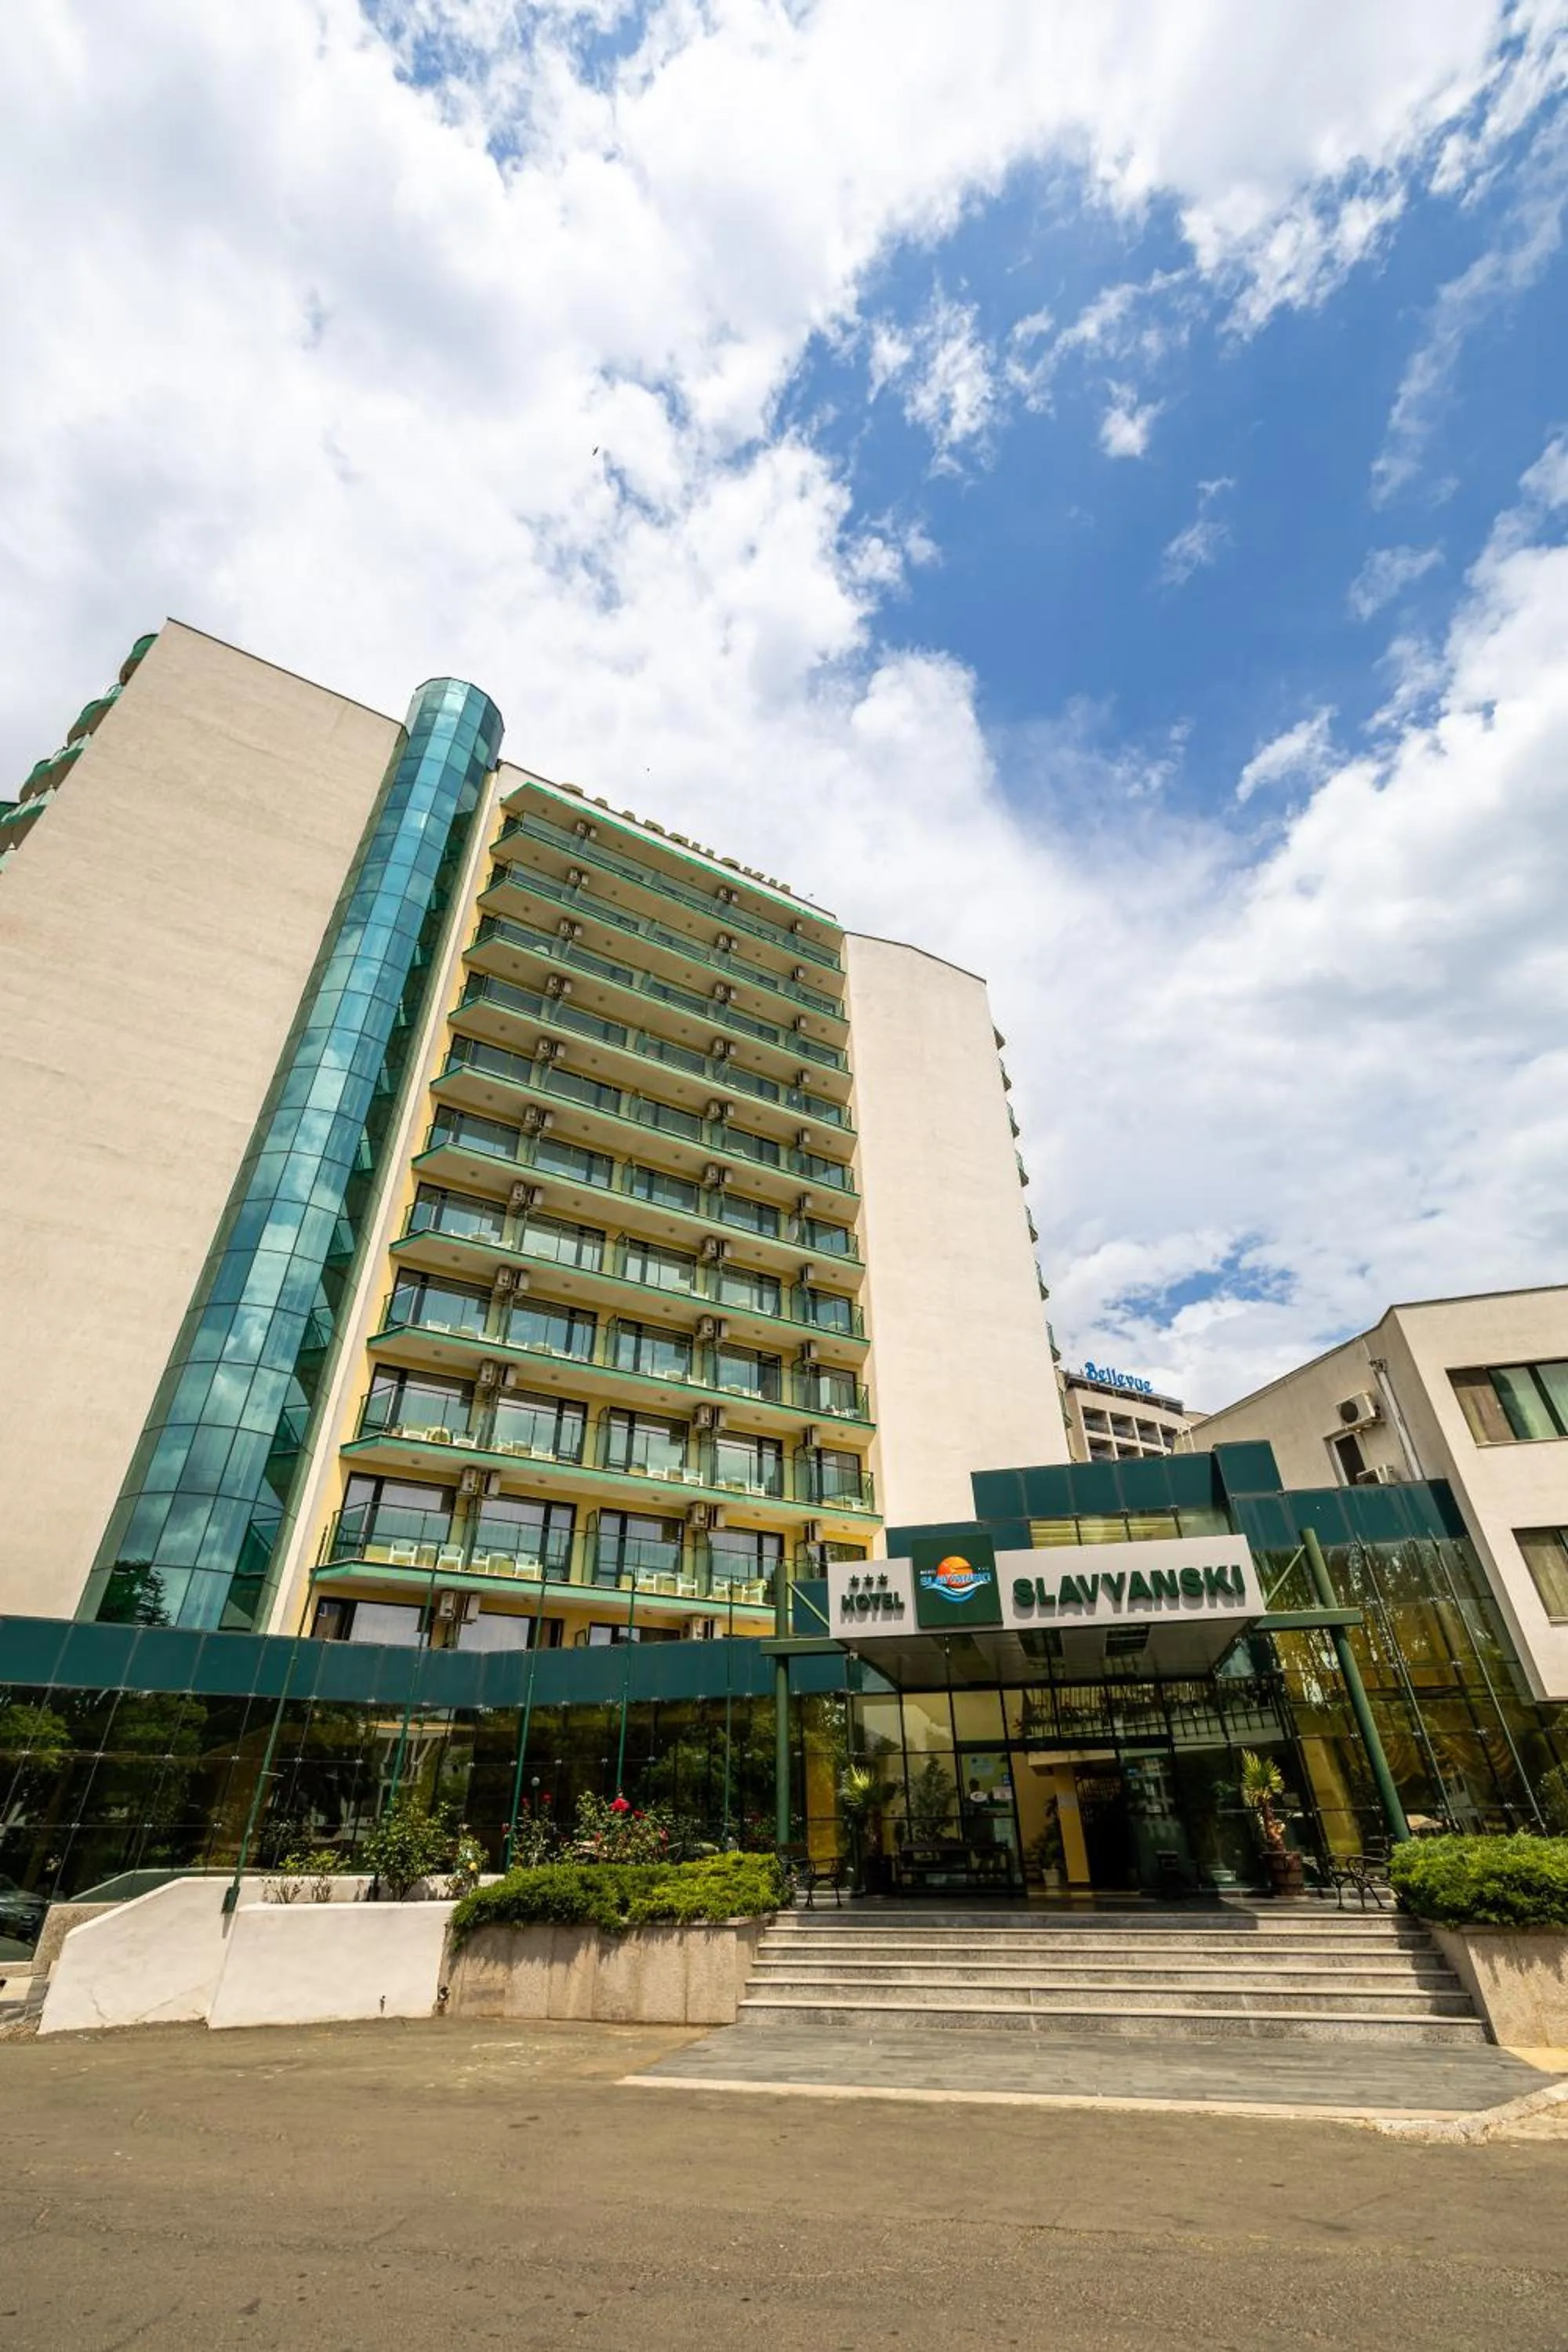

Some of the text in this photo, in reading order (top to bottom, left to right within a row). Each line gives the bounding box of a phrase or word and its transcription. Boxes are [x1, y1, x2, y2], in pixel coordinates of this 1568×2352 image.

[1084, 1361, 1153, 1393] Bellevue
[840, 1591, 906, 1612] HOTEL
[1012, 1564, 1246, 1607] SLAVYANSKI
